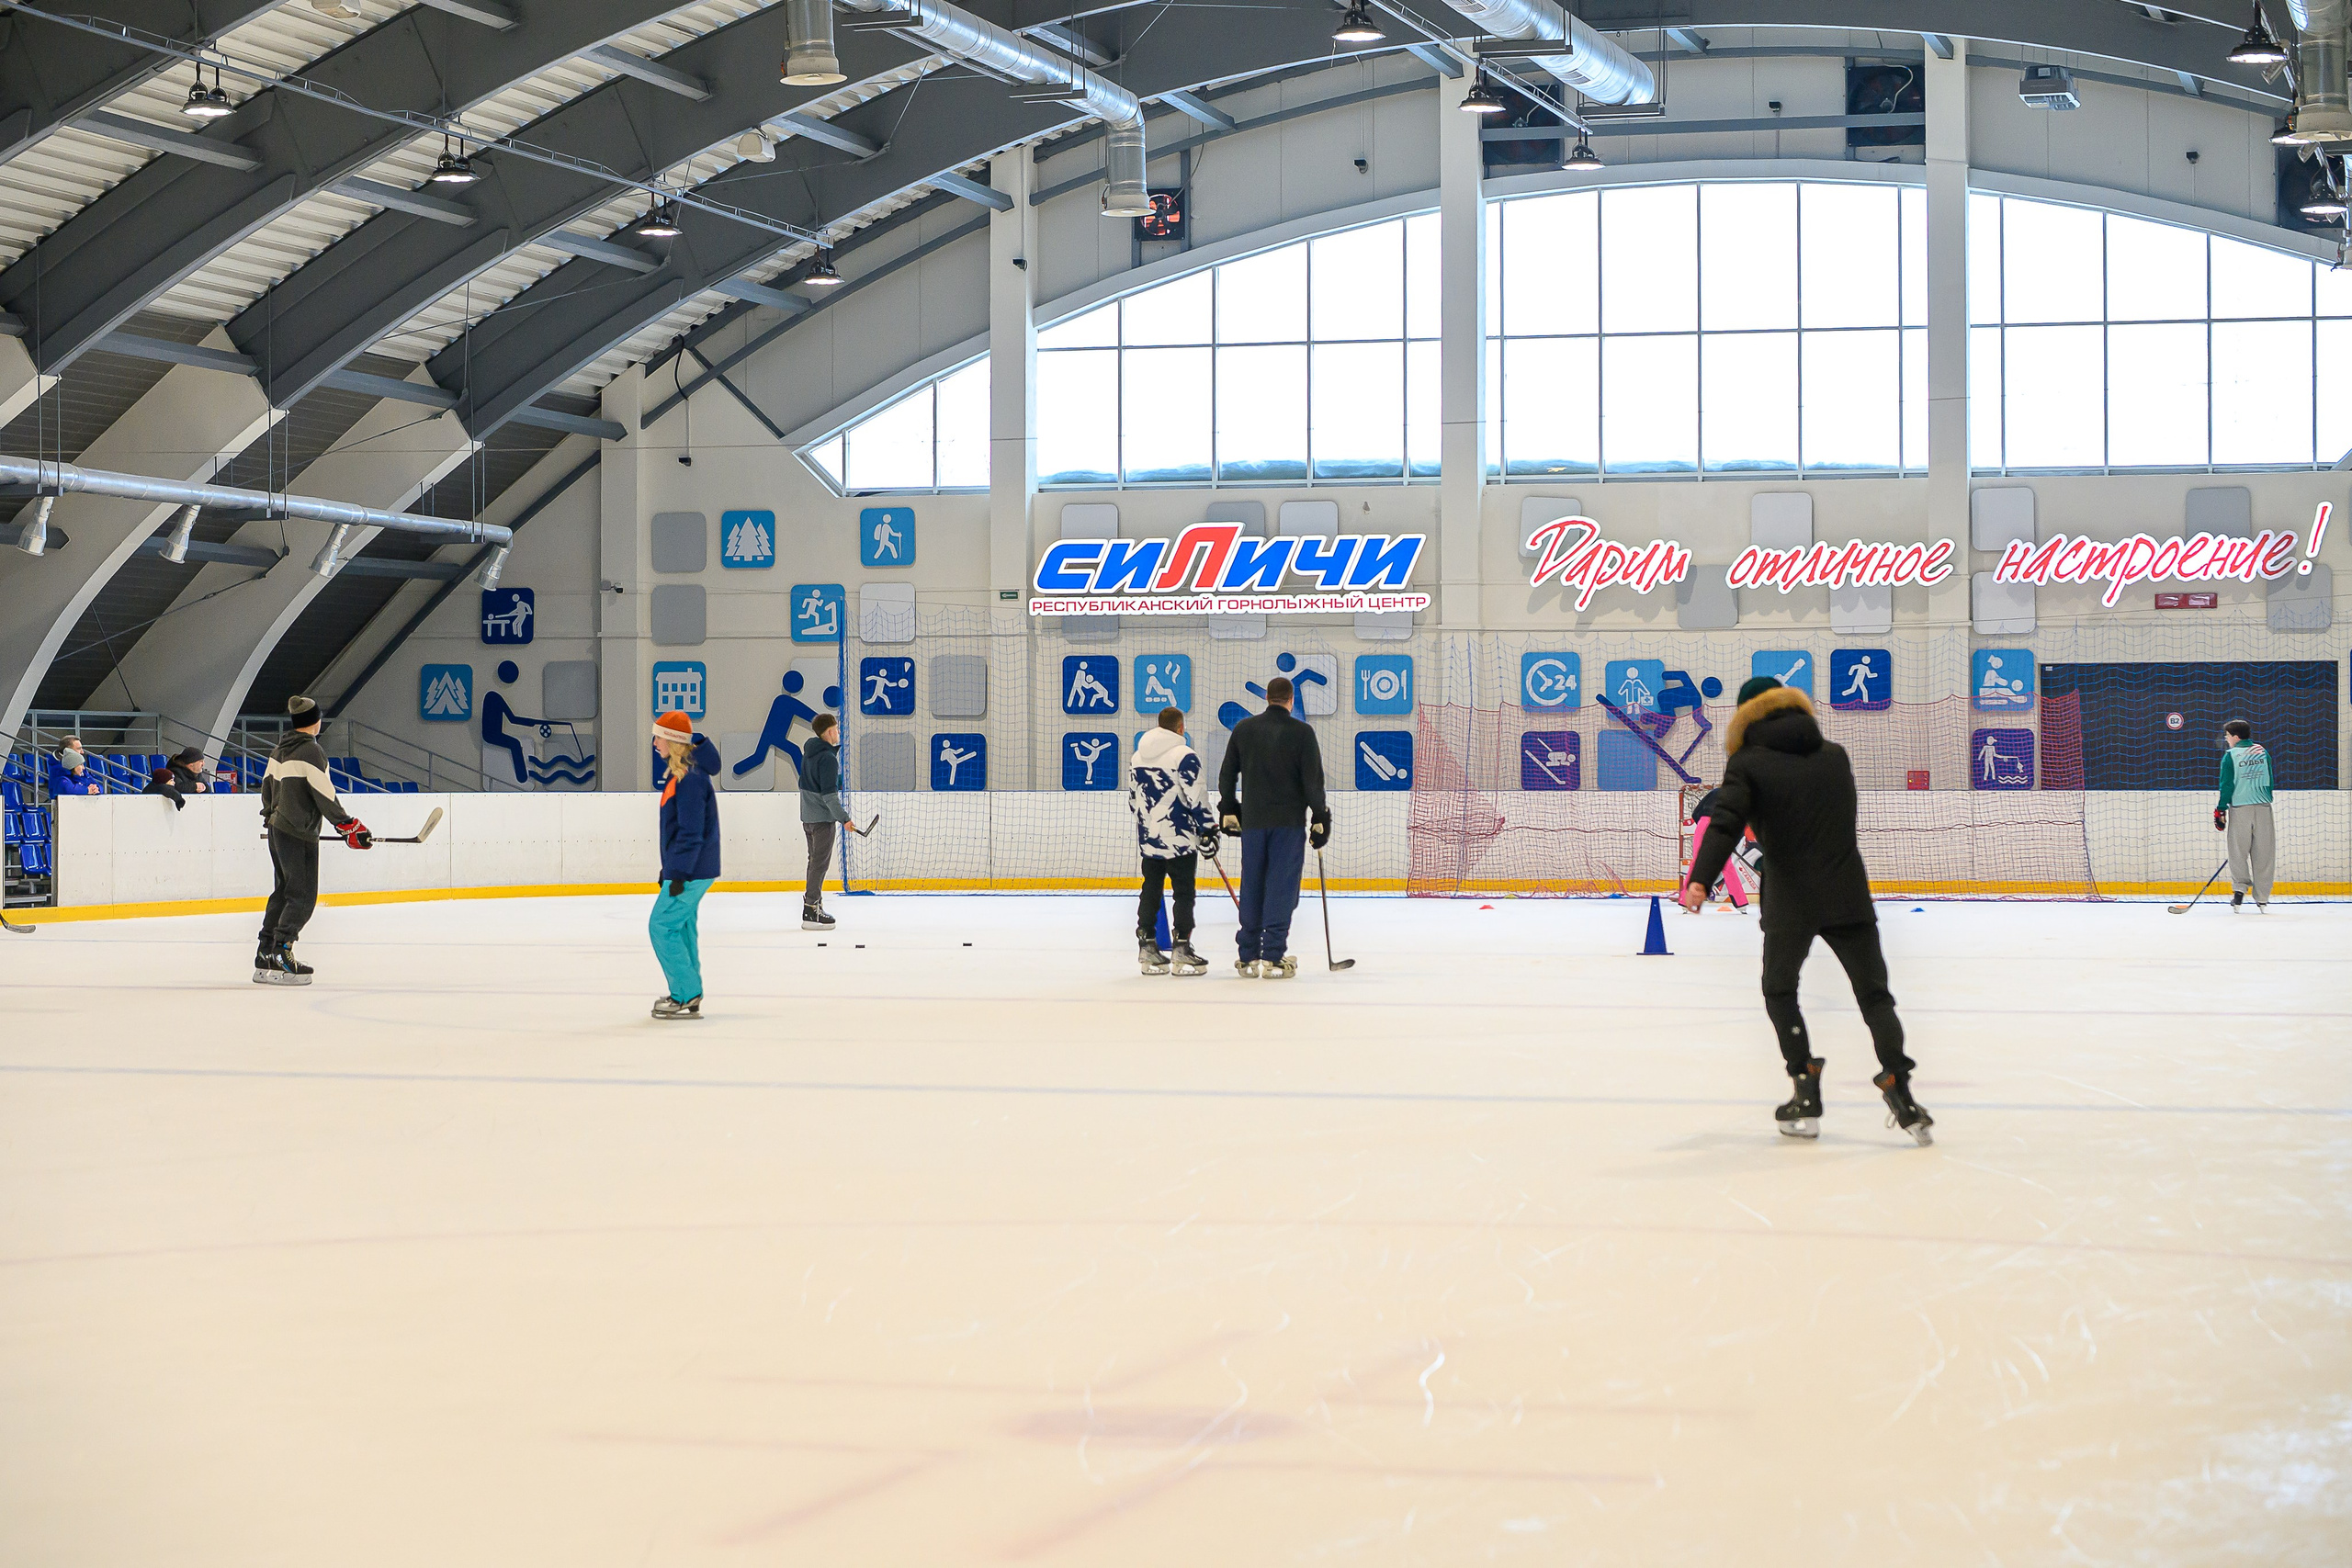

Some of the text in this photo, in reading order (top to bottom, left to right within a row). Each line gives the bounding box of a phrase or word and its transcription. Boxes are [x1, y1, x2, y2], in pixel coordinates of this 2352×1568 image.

[1529, 504, 2329, 608] Дарим отличное настроение!
[1032, 595, 1427, 612] РЕСПУБЛИКАНСКИЙ ГОРНОЛЫЖНЫЙ ЦЕНТР
[1554, 674, 1577, 691] 24
[2238, 759, 2265, 767] СУДЬЯ
[1741, 868, 1757, 890] CANADA
